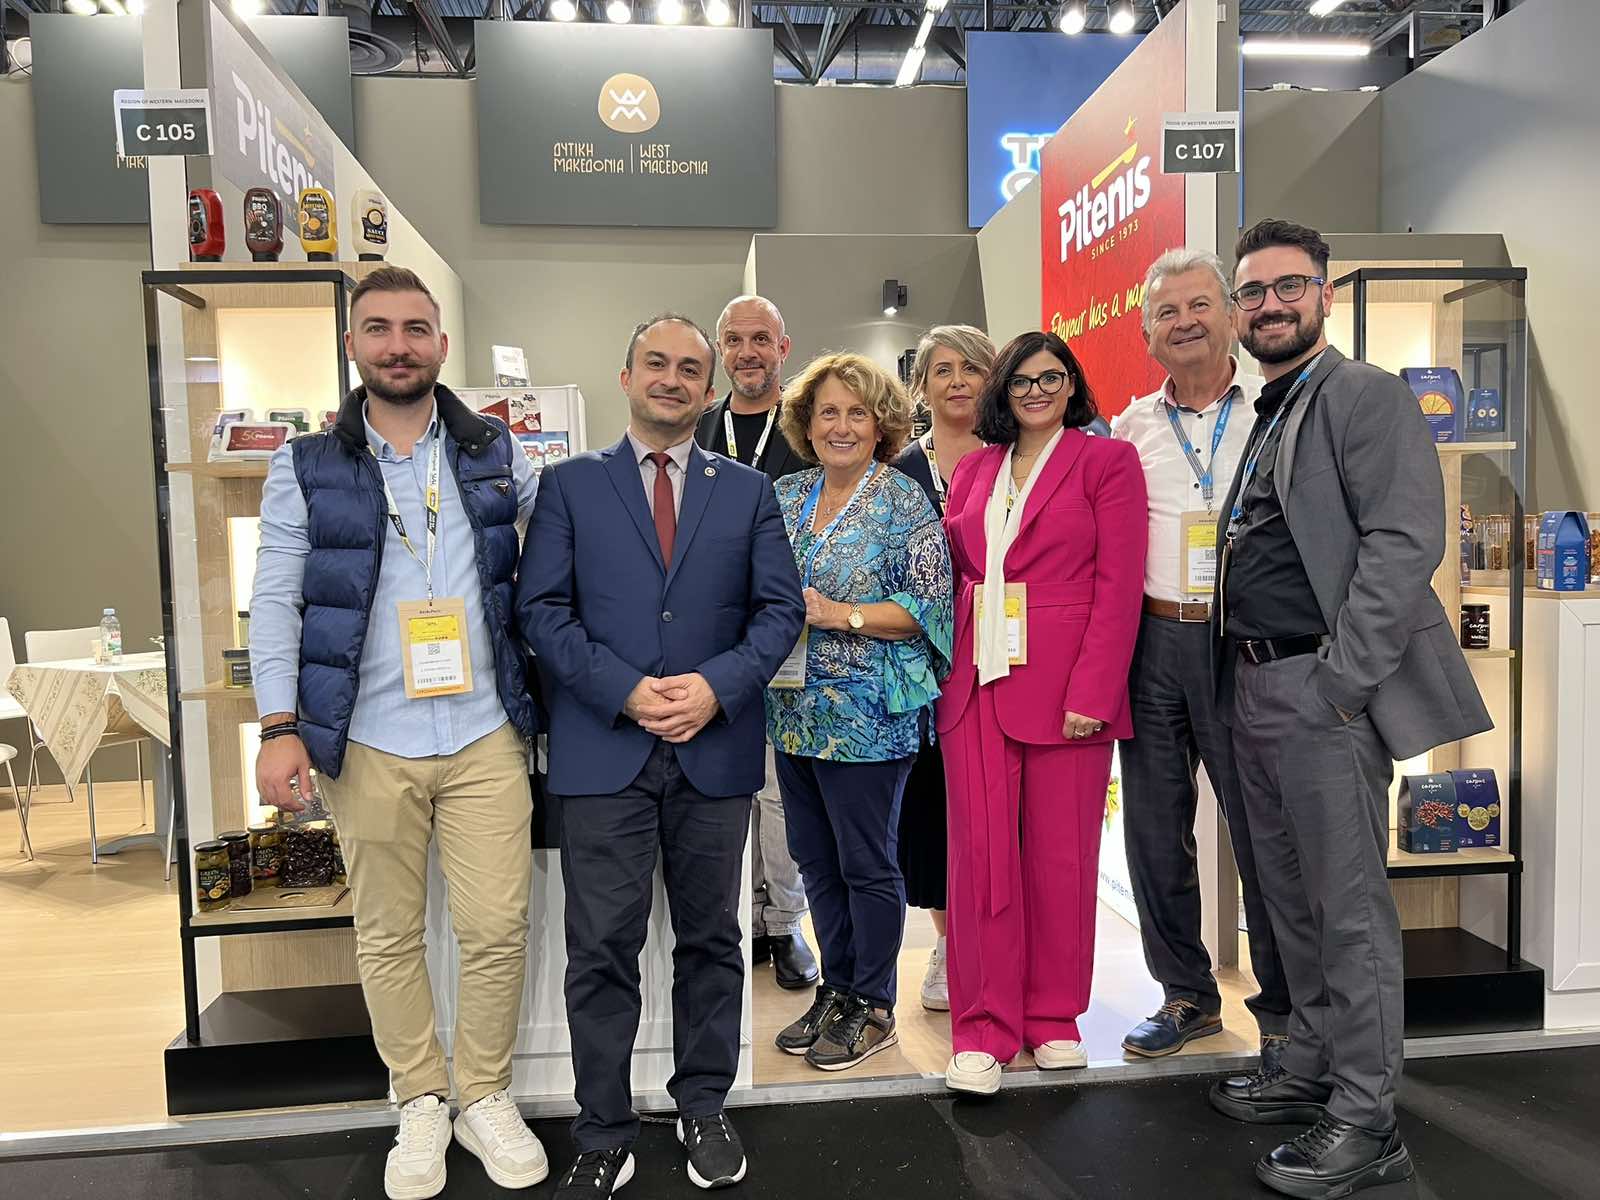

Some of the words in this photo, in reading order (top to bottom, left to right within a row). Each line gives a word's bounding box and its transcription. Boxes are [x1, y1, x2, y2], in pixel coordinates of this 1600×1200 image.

[136, 124, 151, 141] C
[156, 123, 196, 141] 105
[231, 70, 325, 203] Piten
[553, 142, 594, 157] ΔΥΤΙΚΗ
[640, 144, 671, 159] WEST
[1175, 144, 1188, 160] C
[1192, 143, 1225, 159] 107
[640, 159, 709, 175] MACEDONIA
[1058, 155, 1151, 263] Pitenis
[1091, 235, 1116, 261] SINCE
[1119, 218, 1139, 242] 1973
[1088, 295, 1108, 331] has
[1111, 292, 1122, 318] a
